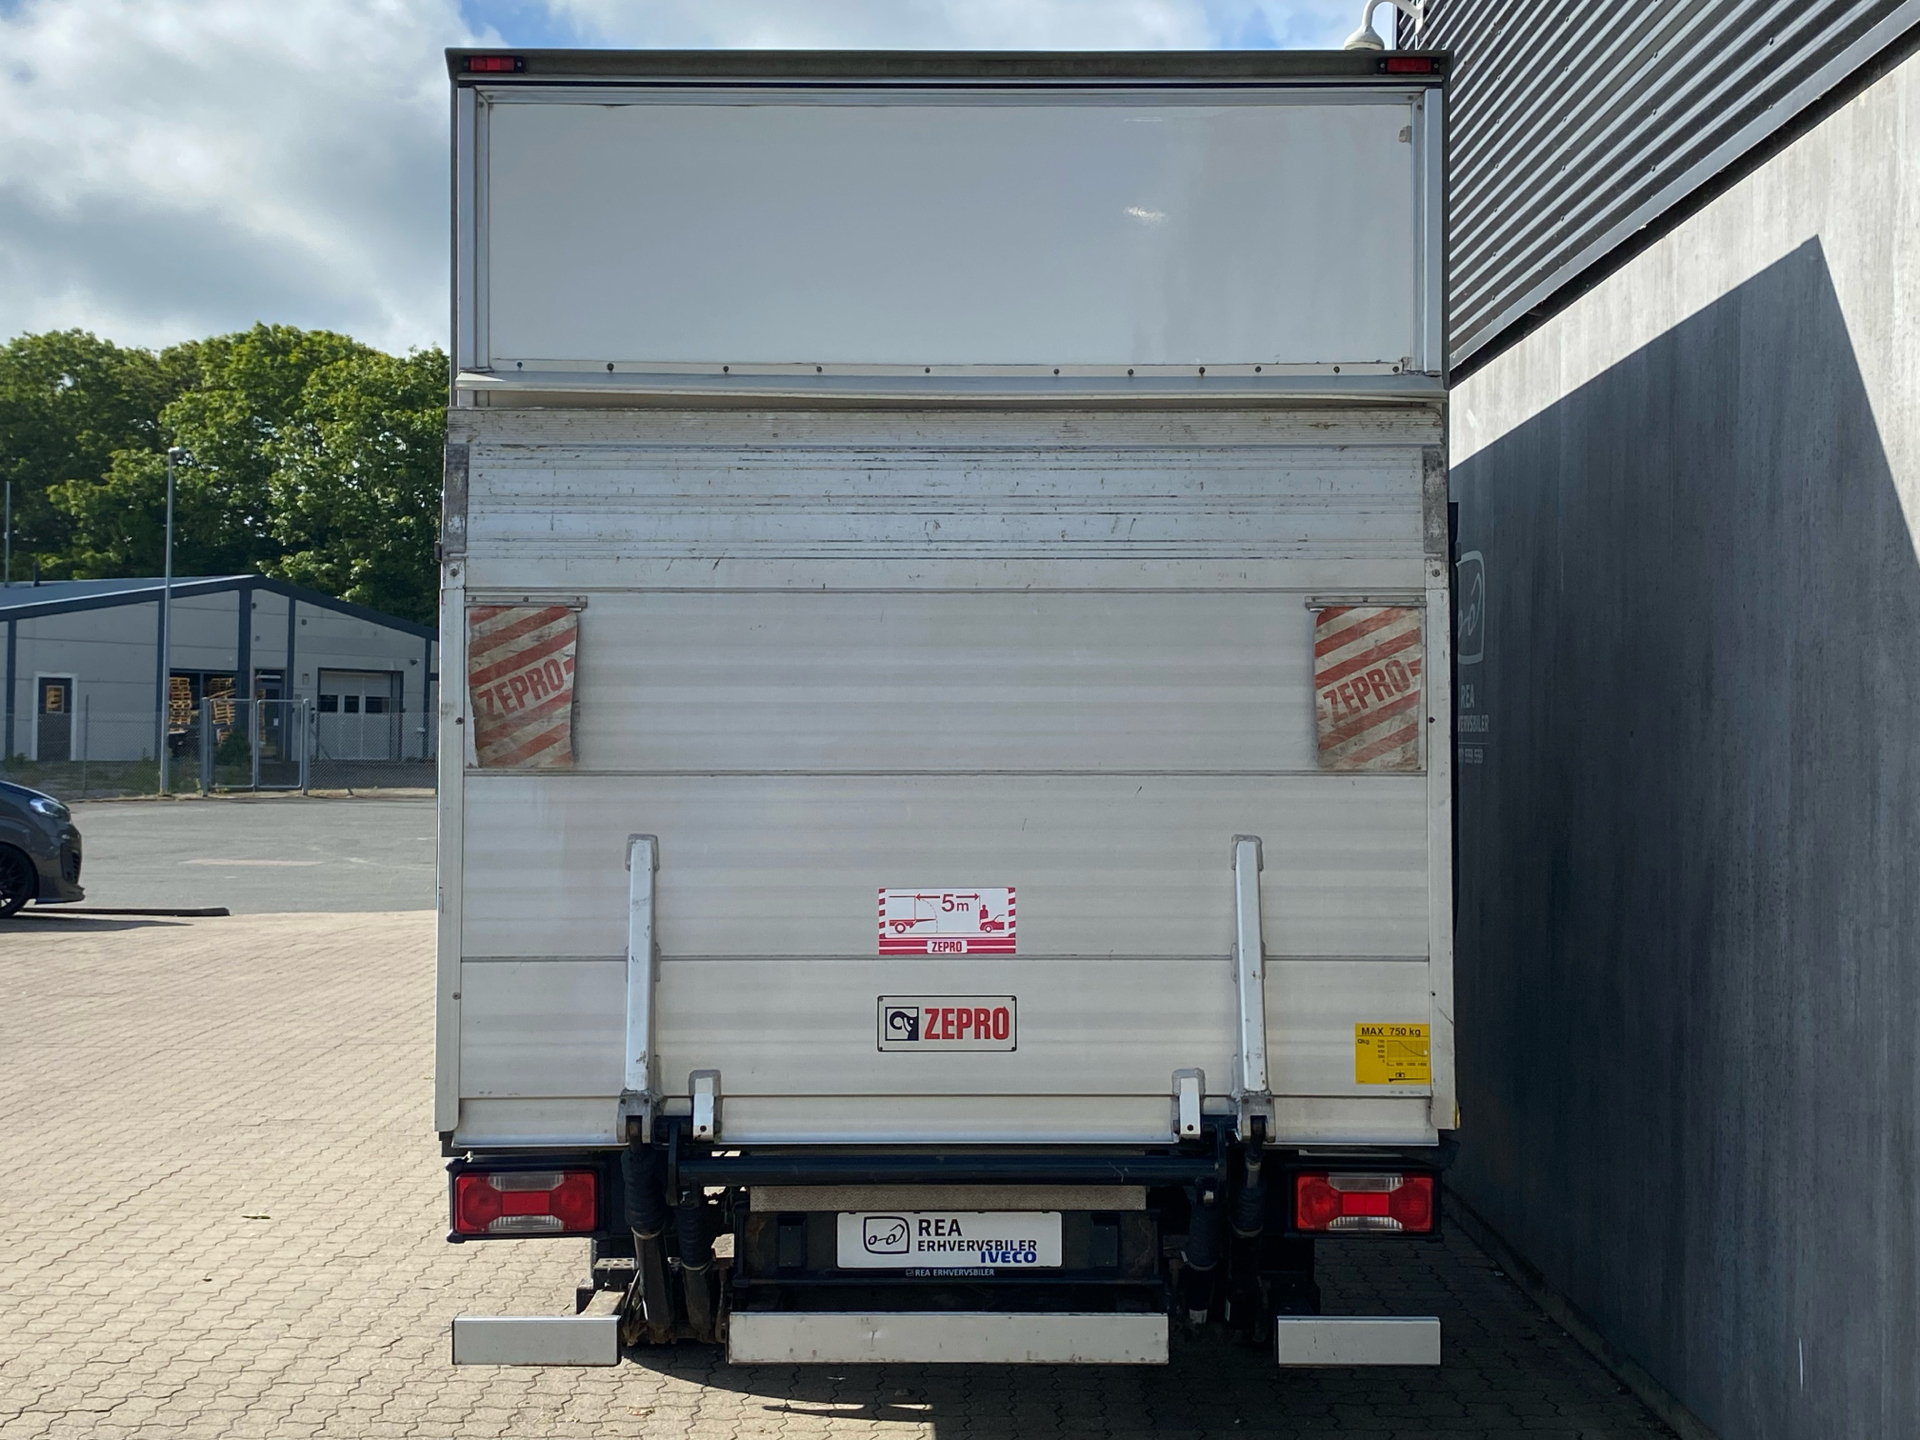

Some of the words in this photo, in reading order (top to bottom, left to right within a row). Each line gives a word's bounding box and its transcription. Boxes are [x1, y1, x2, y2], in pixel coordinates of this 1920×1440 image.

[476, 658, 564, 720] ZEPRO
[1323, 659, 1412, 723] ZEPRO
[932, 940, 963, 953] ZEPRO
[924, 1006, 1010, 1040] ZEPRO
[1361, 1027, 1384, 1036] MAX
[1389, 1027, 1407, 1036] 750
[1409, 1027, 1421, 1037] kg
[918, 1219, 962, 1236] REA
[918, 1240, 1037, 1251] ERHVERVSBILER
[981, 1251, 1037, 1263] IVECO
[915, 1269, 931, 1277] REA
[933, 1268, 995, 1277] ERHVERVSBILER
